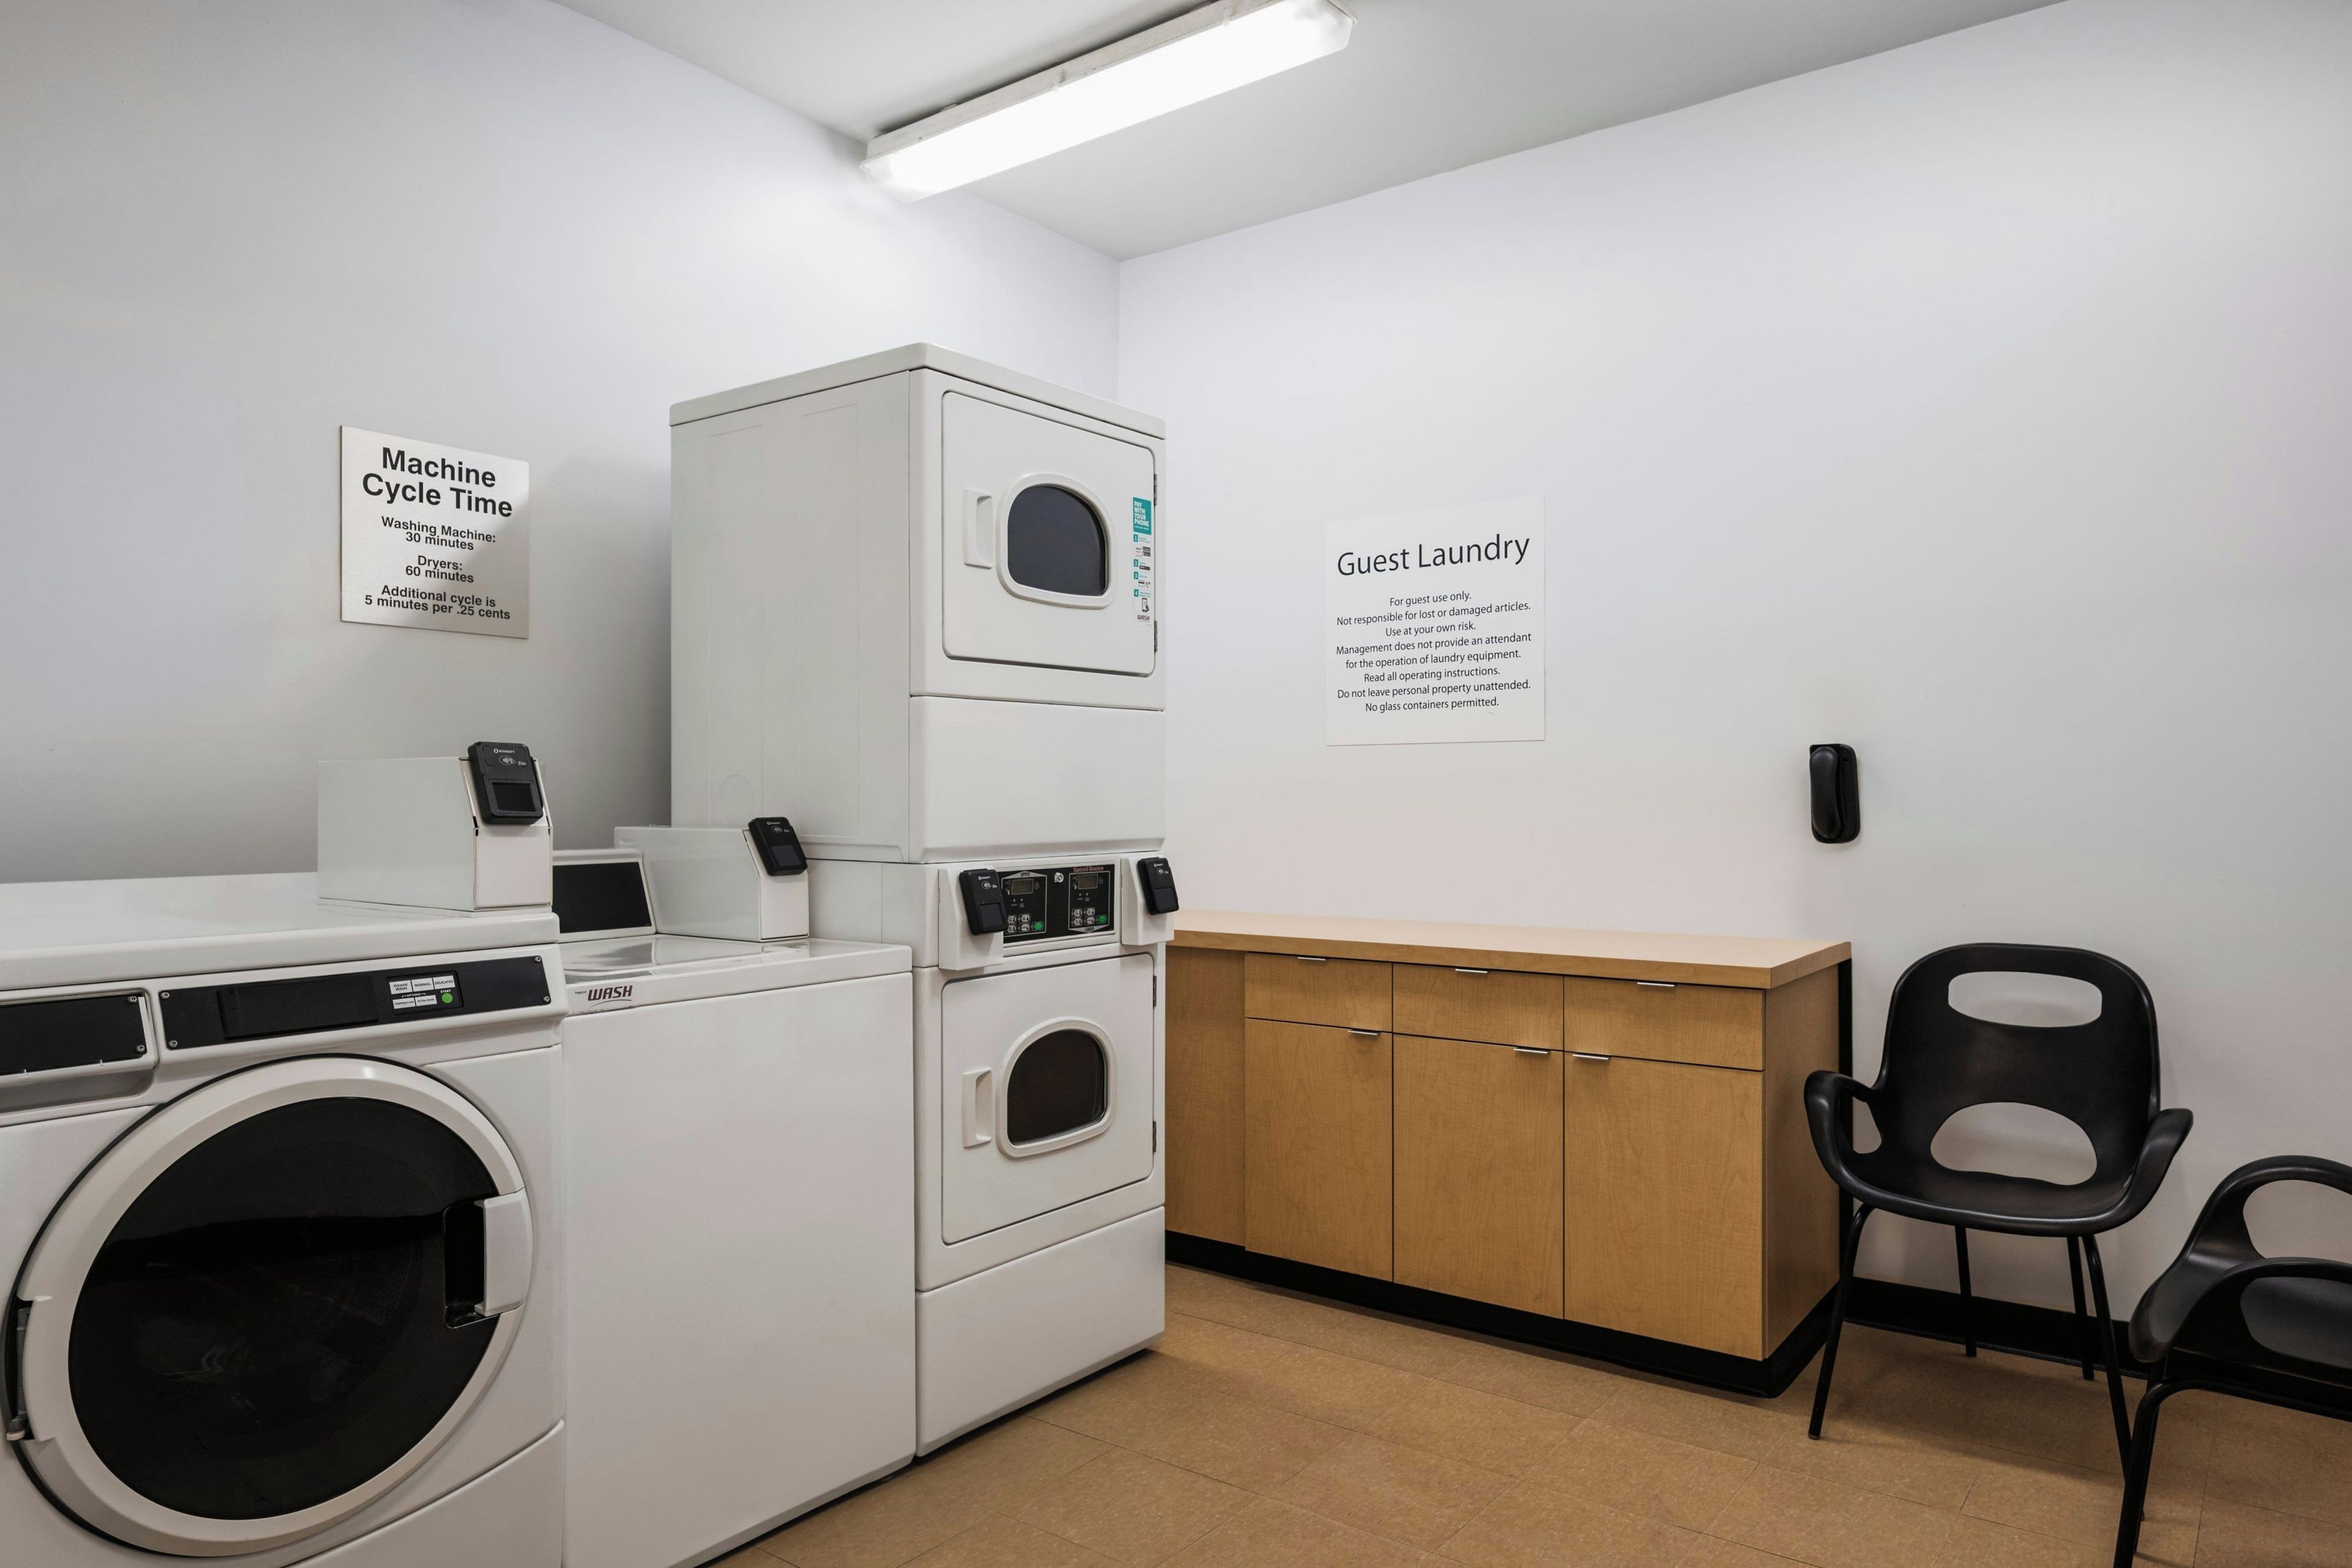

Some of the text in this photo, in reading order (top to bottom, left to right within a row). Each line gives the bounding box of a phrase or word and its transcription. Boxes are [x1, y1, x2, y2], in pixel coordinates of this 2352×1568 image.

[383, 447, 496, 488] Machine
[363, 473, 512, 517] Cycle Time
[381, 516, 496, 543] Washing Machine:
[1134, 518, 1149, 527] PHONE
[405, 532, 473, 550] 30 minutes
[418, 555, 462, 571] Dryers:
[1338, 533, 1530, 576] Guest Laundry
[405, 565, 474, 583] 60 minutes
[381, 585, 496, 607] Additional cycle is
[1390, 597, 1404, 606] For
[1406, 595, 1430, 608] guest
[1450, 590, 1471, 602] only.
[365, 595, 510, 619] 5 minutes per .25 cents
[1337, 617, 1352, 625] Not
[1354, 612, 1403, 625] responsible
[1405, 611, 1417, 620] for
[1419, 609, 1435, 619] lost
[1449, 603, 1492, 617] damaged
[1494, 601, 1531, 612] articles.
[1385, 627, 1401, 636] Use
[1414, 626, 1434, 636] your
[1458, 620, 1476, 631] risk.
[1336, 643, 1392, 655] Management
[1395, 641, 1415, 650] does
[1435, 636, 1469, 650] provide
[1485, 633, 1531, 644] attendant
[1346, 650, 1521, 669] for the operation of laundry equipment.
[1364, 666, 1500, 682] Read all operating instructions.
[1338, 690, 1349, 698] Do
[1368, 688, 1390, 696] leave
[1392, 684, 1430, 698] personal
[1432, 684, 1471, 696] property
[1474, 679, 1531, 692] unattended.
[1366, 696, 1499, 714] No glass containers permitted.
[588, 985, 633, 1001] WASH
